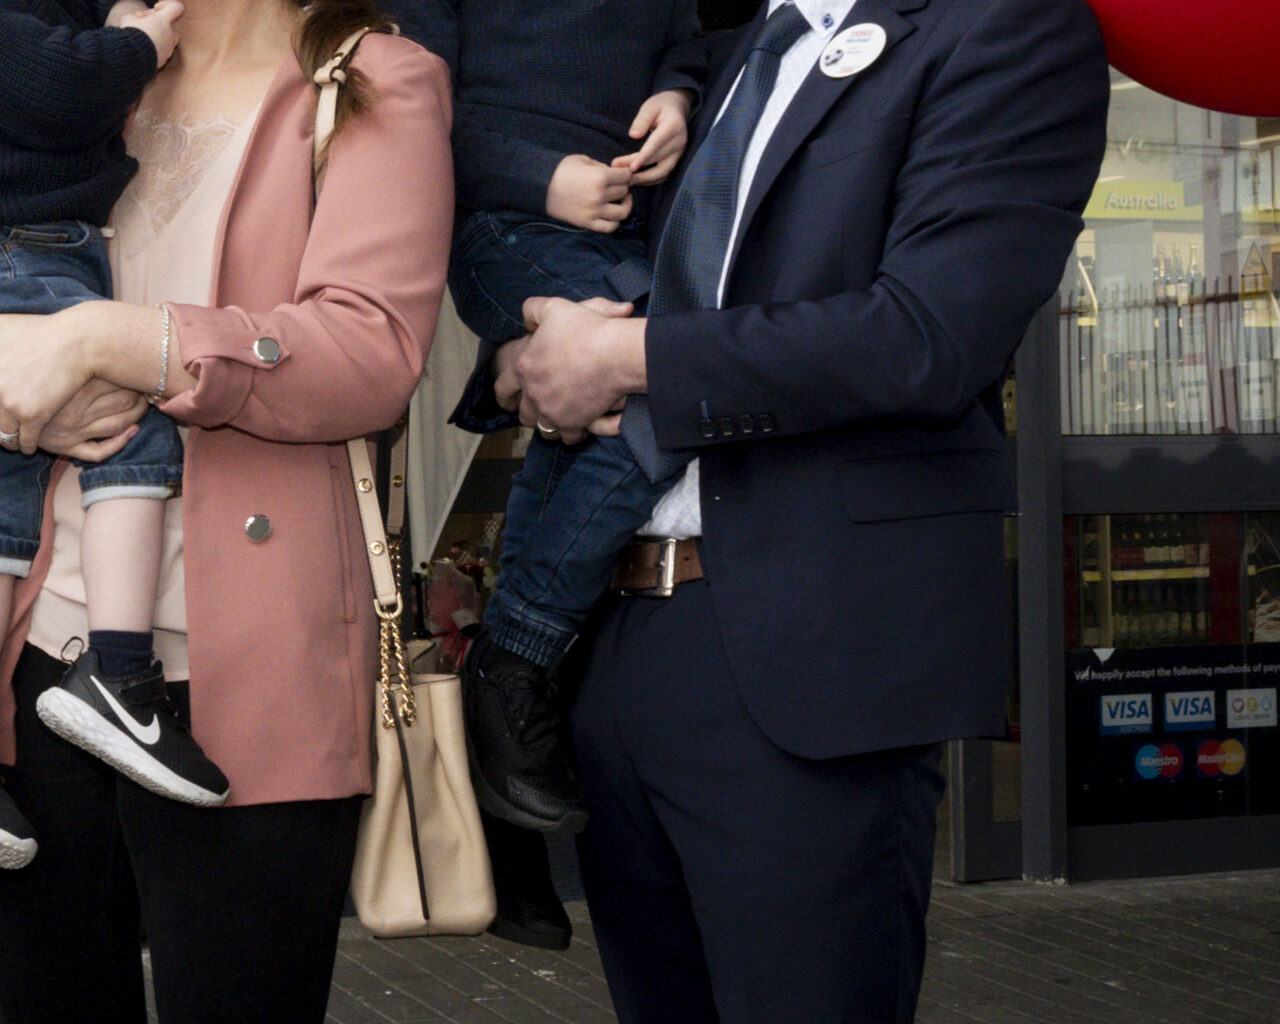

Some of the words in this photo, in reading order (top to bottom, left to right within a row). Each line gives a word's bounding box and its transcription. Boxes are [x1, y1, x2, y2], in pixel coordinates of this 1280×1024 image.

[1104, 191, 1178, 211] Australia
[1091, 668, 1124, 682] happily
[1125, 668, 1155, 680] accept
[1157, 666, 1171, 678] the
[1172, 664, 1213, 679] following
[1214, 662, 1251, 675] methods
[1252, 662, 1262, 673] of
[1105, 699, 1149, 719] VISA
[1169, 696, 1212, 716] VISA
[1140, 755, 1179, 768] Maestro
[1197, 753, 1245, 766] MasterCard
